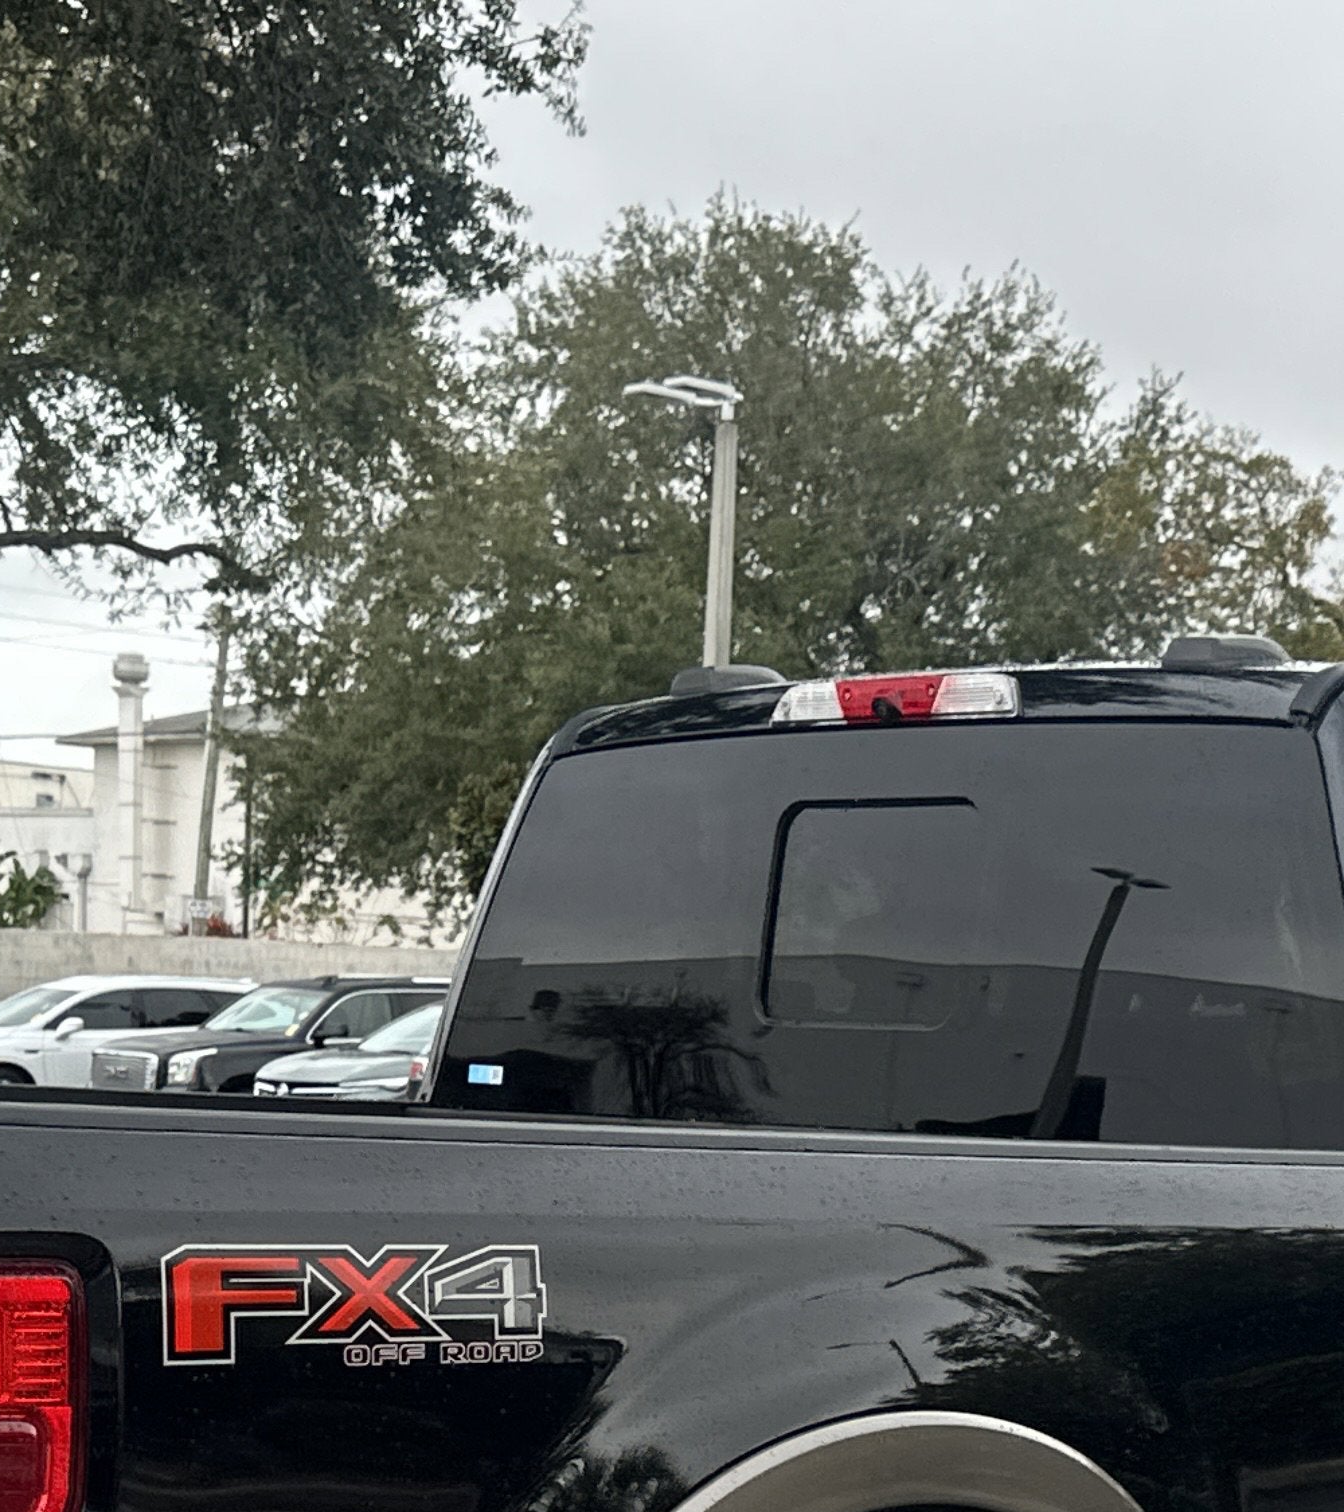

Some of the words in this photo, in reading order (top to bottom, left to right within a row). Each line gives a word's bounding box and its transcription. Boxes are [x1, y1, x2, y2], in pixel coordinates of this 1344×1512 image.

[161, 1244, 547, 1366] FX4
[343, 1343, 426, 1367] OFF
[440, 1341, 544, 1364] ROAD
